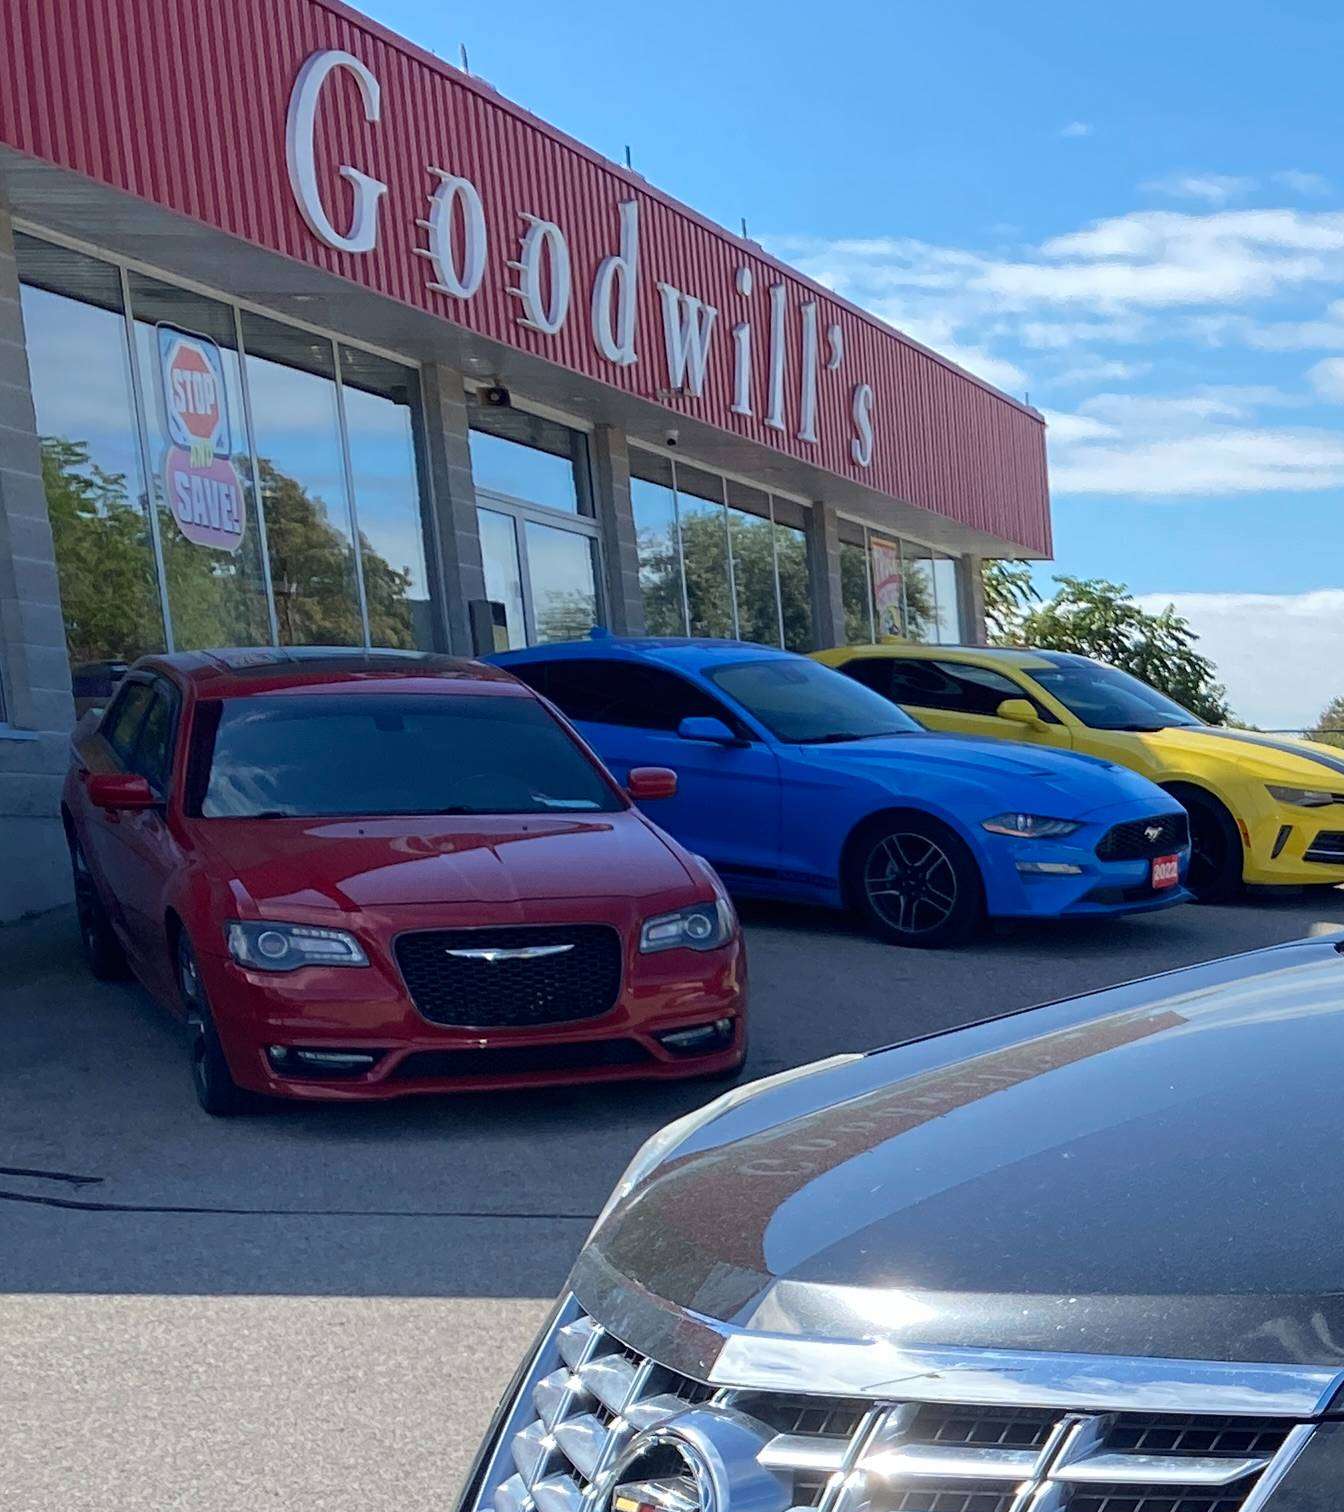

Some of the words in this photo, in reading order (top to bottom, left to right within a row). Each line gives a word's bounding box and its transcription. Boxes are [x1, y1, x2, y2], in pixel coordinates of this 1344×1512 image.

[285, 49, 875, 468] Goodwill's
[173, 368, 217, 415] STOP
[174, 470, 241, 533] SAVE!
